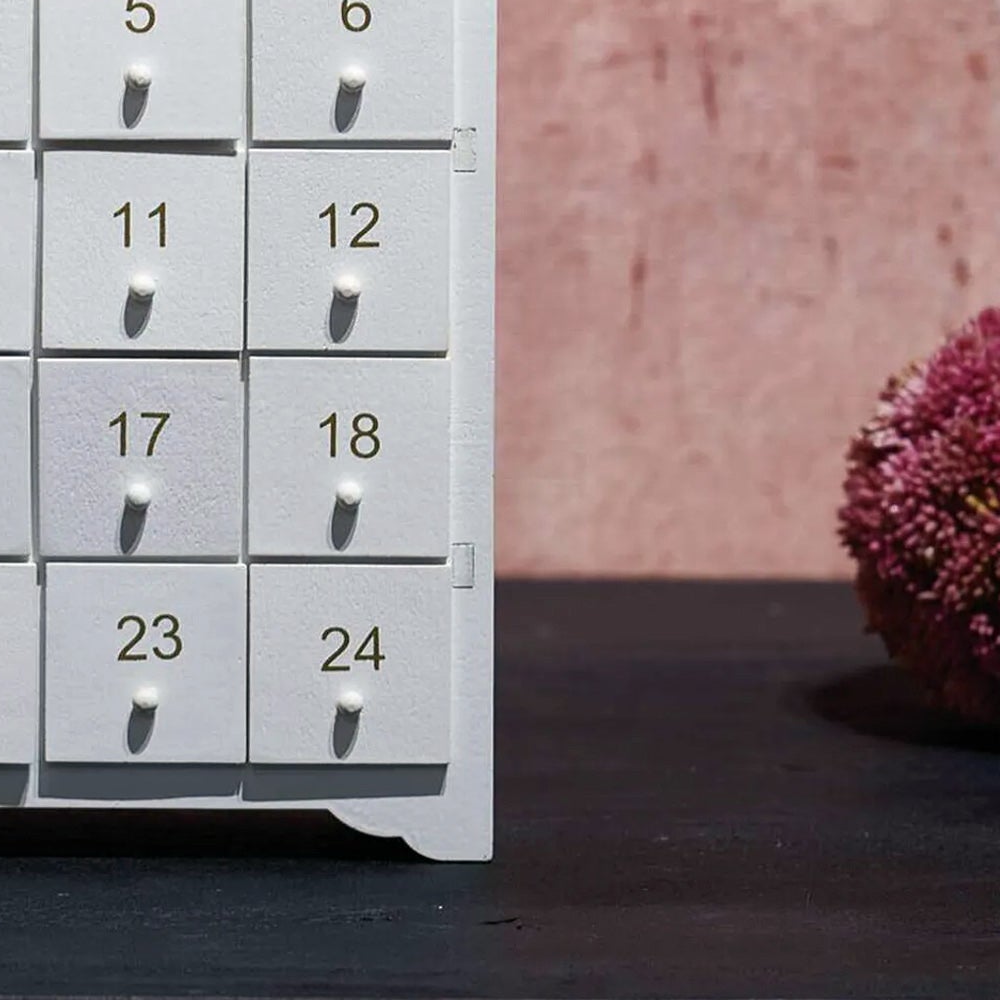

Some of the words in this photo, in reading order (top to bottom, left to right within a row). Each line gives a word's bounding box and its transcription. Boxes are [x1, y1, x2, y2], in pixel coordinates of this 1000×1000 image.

[112, 201, 167, 249] 11
[318, 202, 381, 249] 12
[108, 410, 171, 458] 17
[319, 411, 381, 460] 18
[116, 613, 183, 662] 23
[320, 625, 386, 673] 24
